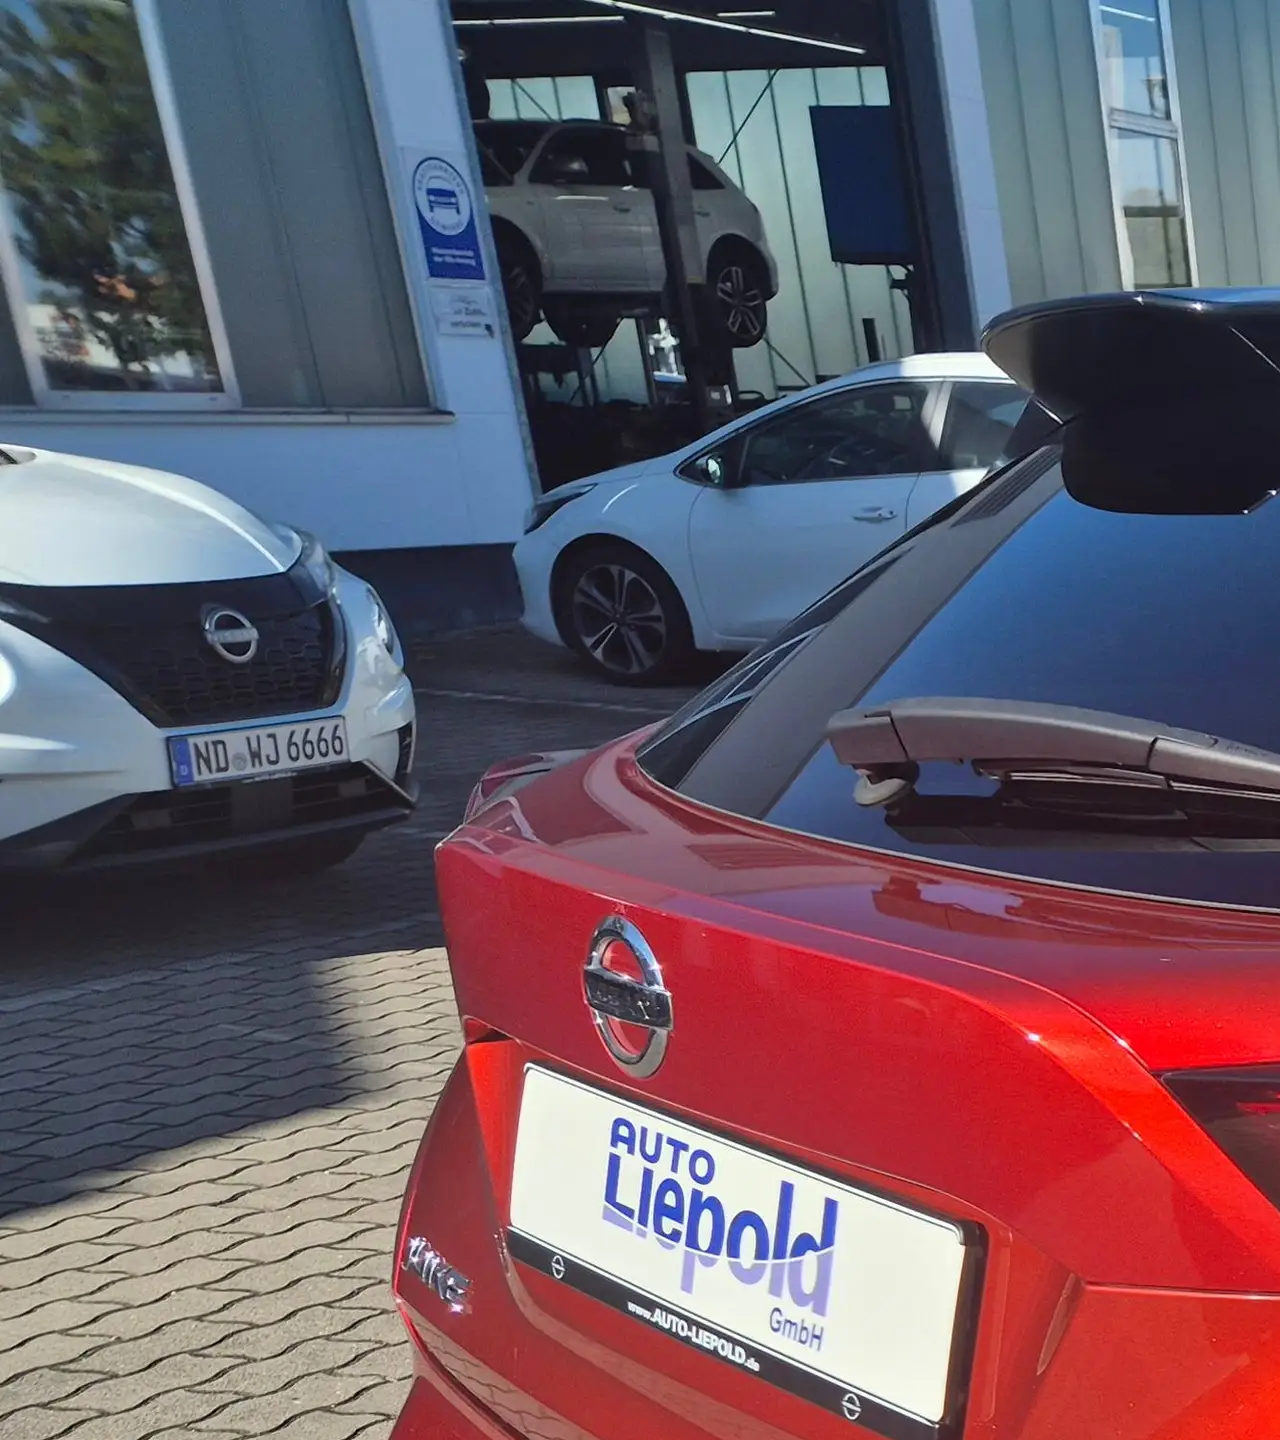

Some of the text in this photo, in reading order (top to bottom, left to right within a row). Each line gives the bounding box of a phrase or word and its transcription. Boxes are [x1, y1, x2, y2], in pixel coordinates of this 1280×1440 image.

[193, 738, 230, 776] ND
[610, 1117, 716, 1186] AUTO
[626, 1301, 761, 1373] www.AUTO-LIEPOLD.de
[769, 1306, 825, 1352] GmbH
